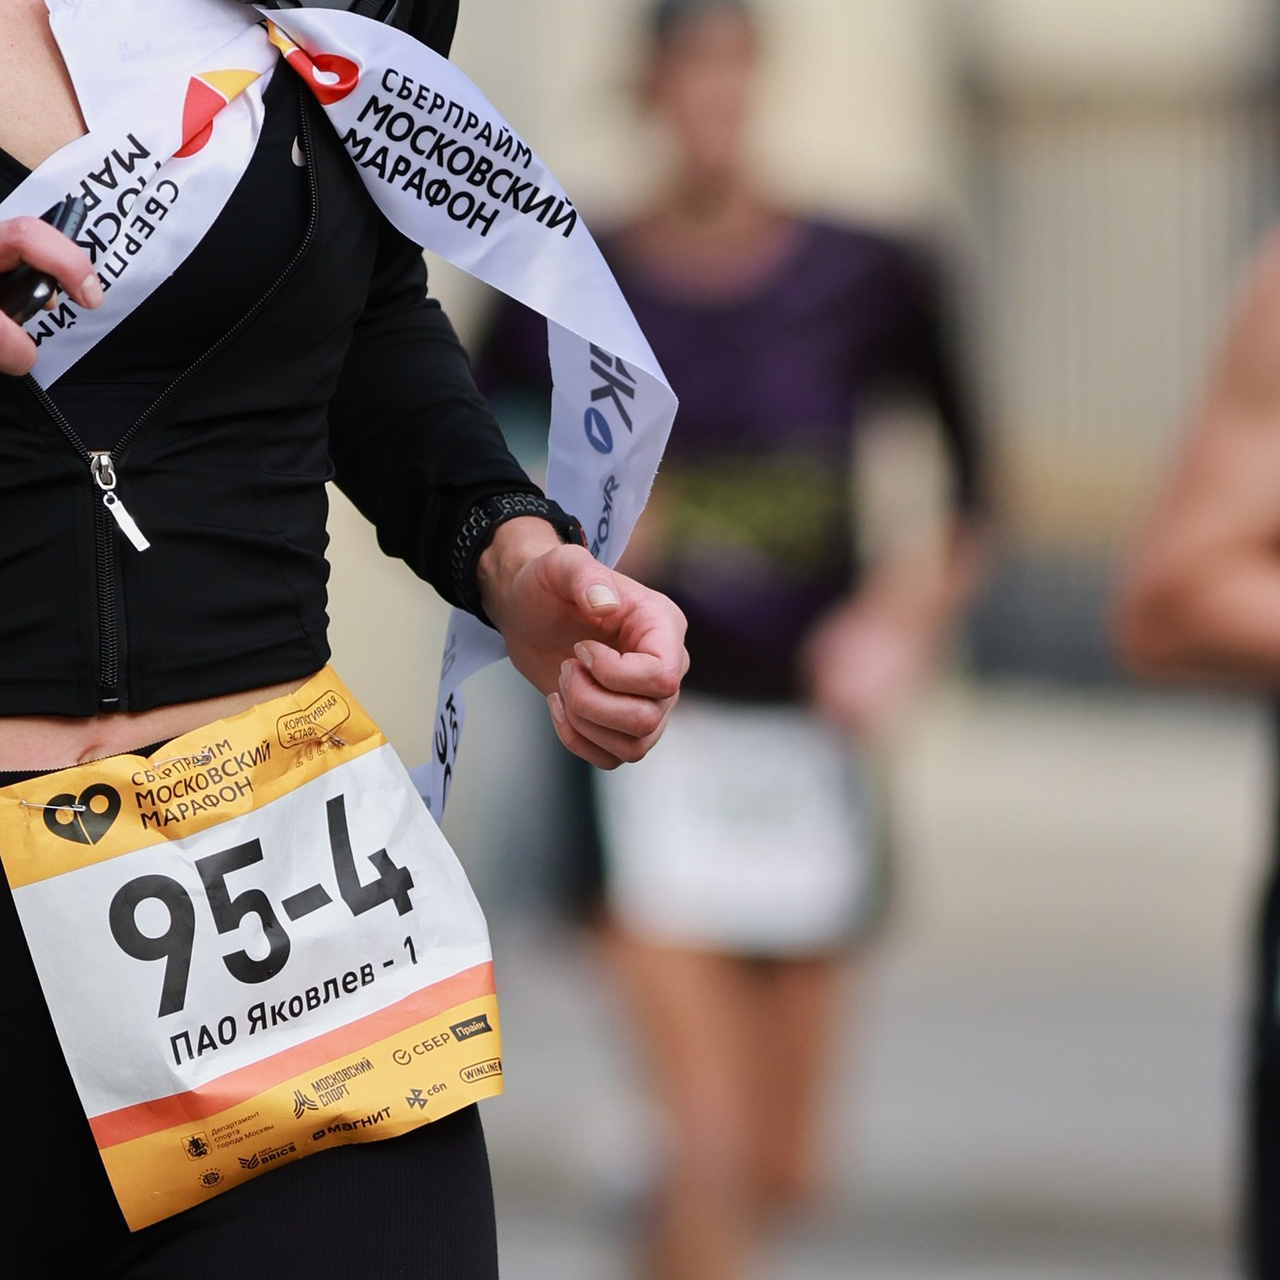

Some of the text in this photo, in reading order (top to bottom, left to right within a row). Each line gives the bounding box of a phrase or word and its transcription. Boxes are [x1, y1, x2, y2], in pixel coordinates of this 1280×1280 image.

[382, 68, 532, 169] СБЕРПРАЙМ
[342, 127, 500, 237] МАРАФОН
[357, 95, 577, 238] МОСКОВСКИЙ
[27, 180, 179, 347] СБЕРПЙМ
[135, 739, 271, 808] МОСКОВСКИЙ
[140, 776, 254, 830] МАРАФОН
[108, 793, 415, 1018] 95-4
[169, 1014, 237, 1066] ПАО
[247, 962, 375, 1035] Яковлев
[403, 935, 418, 965] 1
[412, 1021, 486, 1055] СБЕР Прайм
[310, 1057, 375, 1095] МОСКОВСКИЙ
[426, 1083, 448, 1096] сбп
[464, 1062, 498, 1080] WINLINE
[318, 1083, 350, 1107] СПОРТ
[211, 1111, 260, 1136] Департамент
[214, 1128, 240, 1143] спорта
[217, 1124, 274, 1150] города Москвы
[260, 1145, 297, 1164] BRICS
